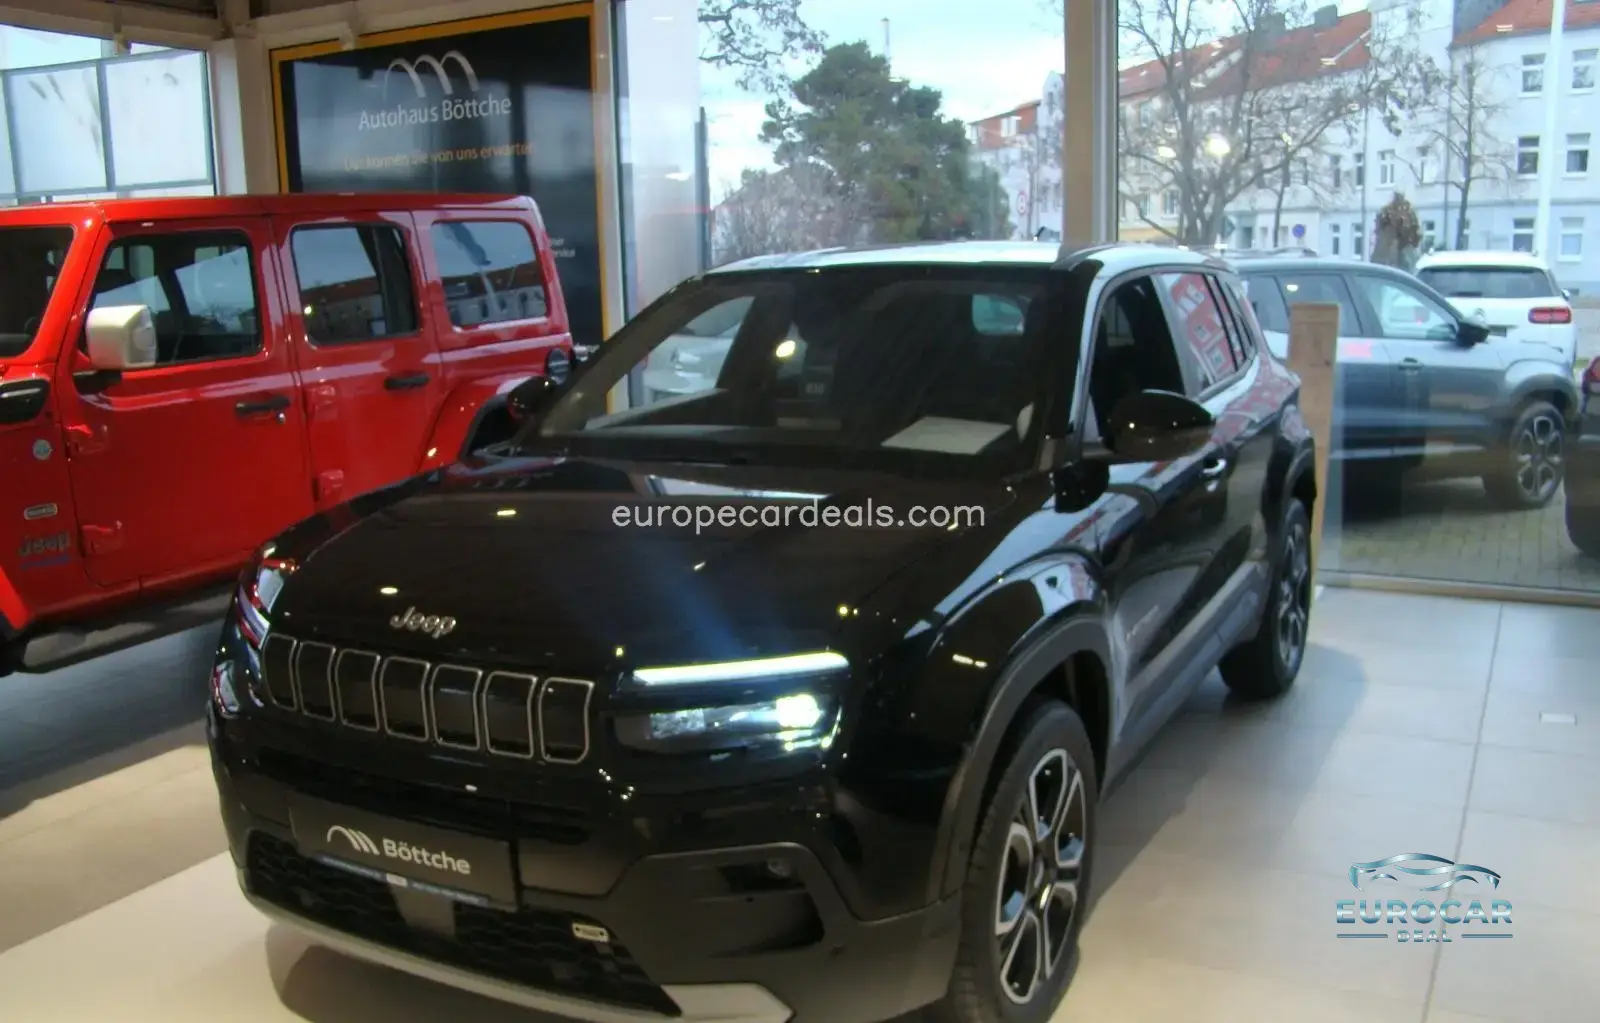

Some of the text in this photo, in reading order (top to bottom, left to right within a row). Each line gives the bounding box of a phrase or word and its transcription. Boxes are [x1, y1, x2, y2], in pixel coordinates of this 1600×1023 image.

[358, 93, 512, 131] Autohaus Böttche
[456, 147, 478, 162] uns
[389, 605, 457, 640] Jeep
[383, 838, 471, 875] Böttche
